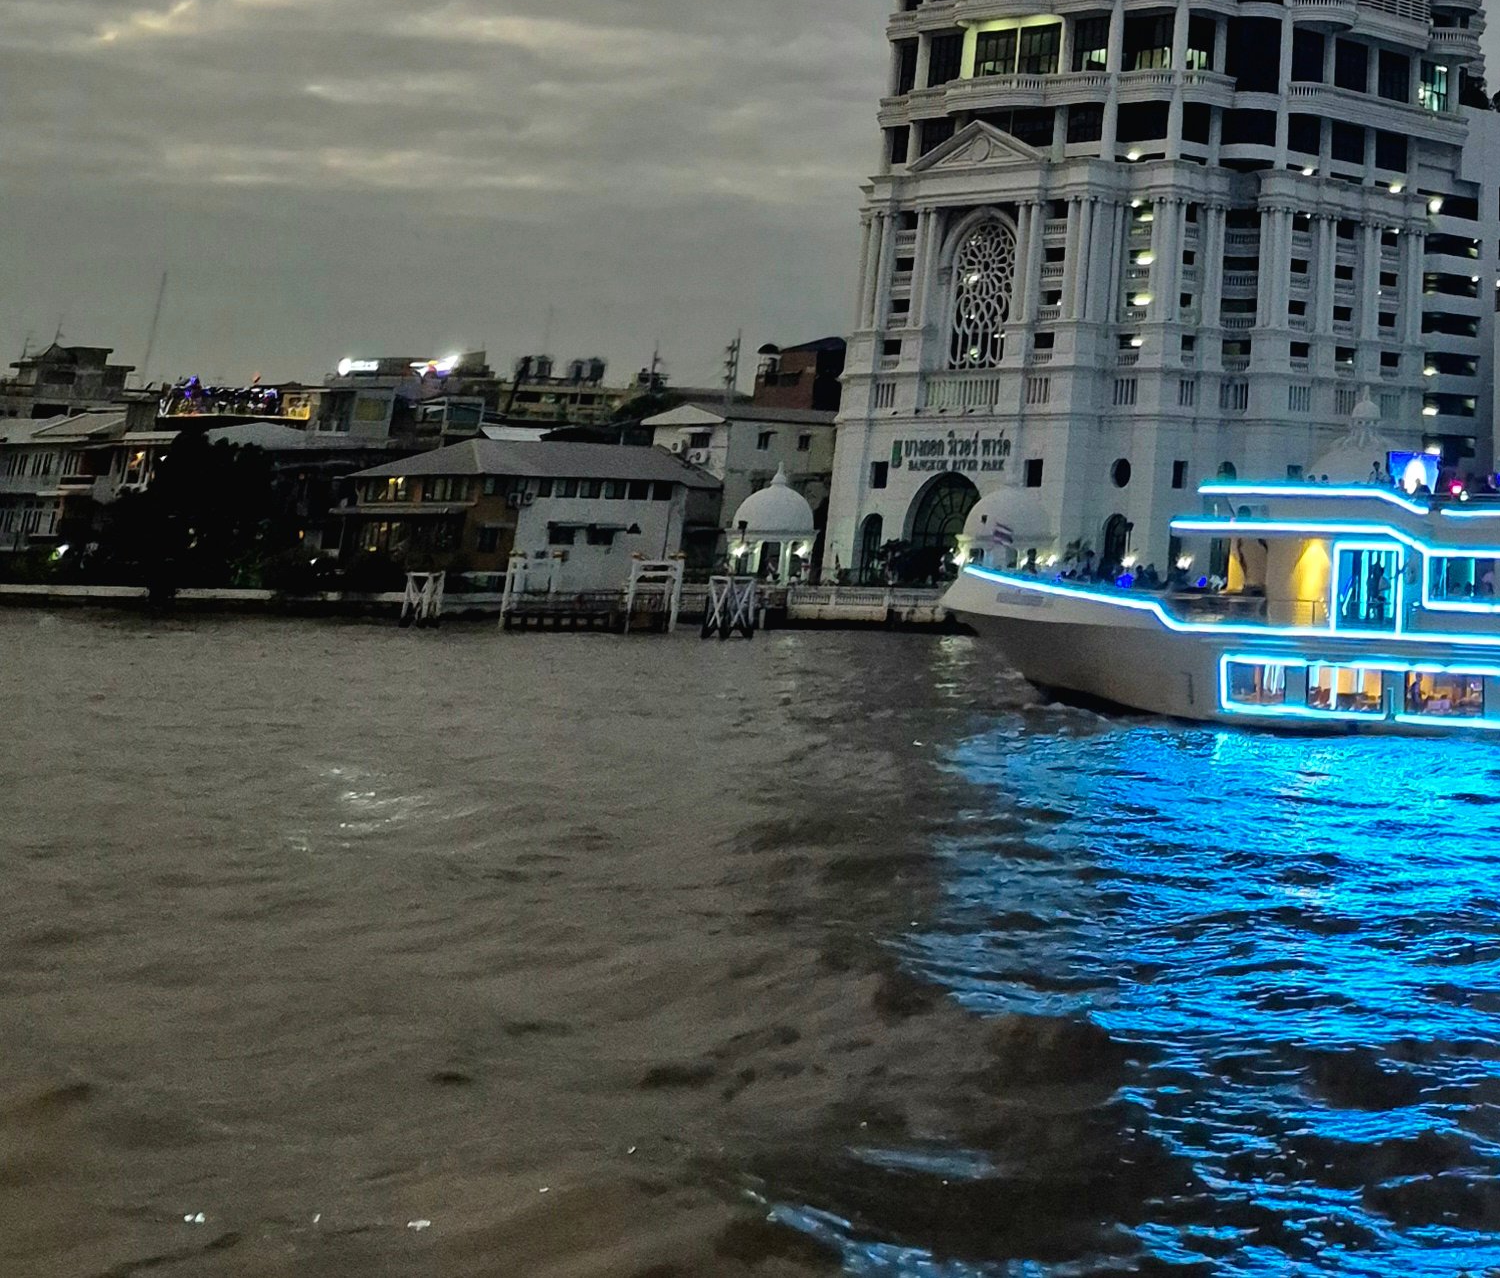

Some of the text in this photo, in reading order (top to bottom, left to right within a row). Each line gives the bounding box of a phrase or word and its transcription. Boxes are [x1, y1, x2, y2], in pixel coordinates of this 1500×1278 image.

[908, 459, 1005, 471] BANGKOK RIVER PARK
